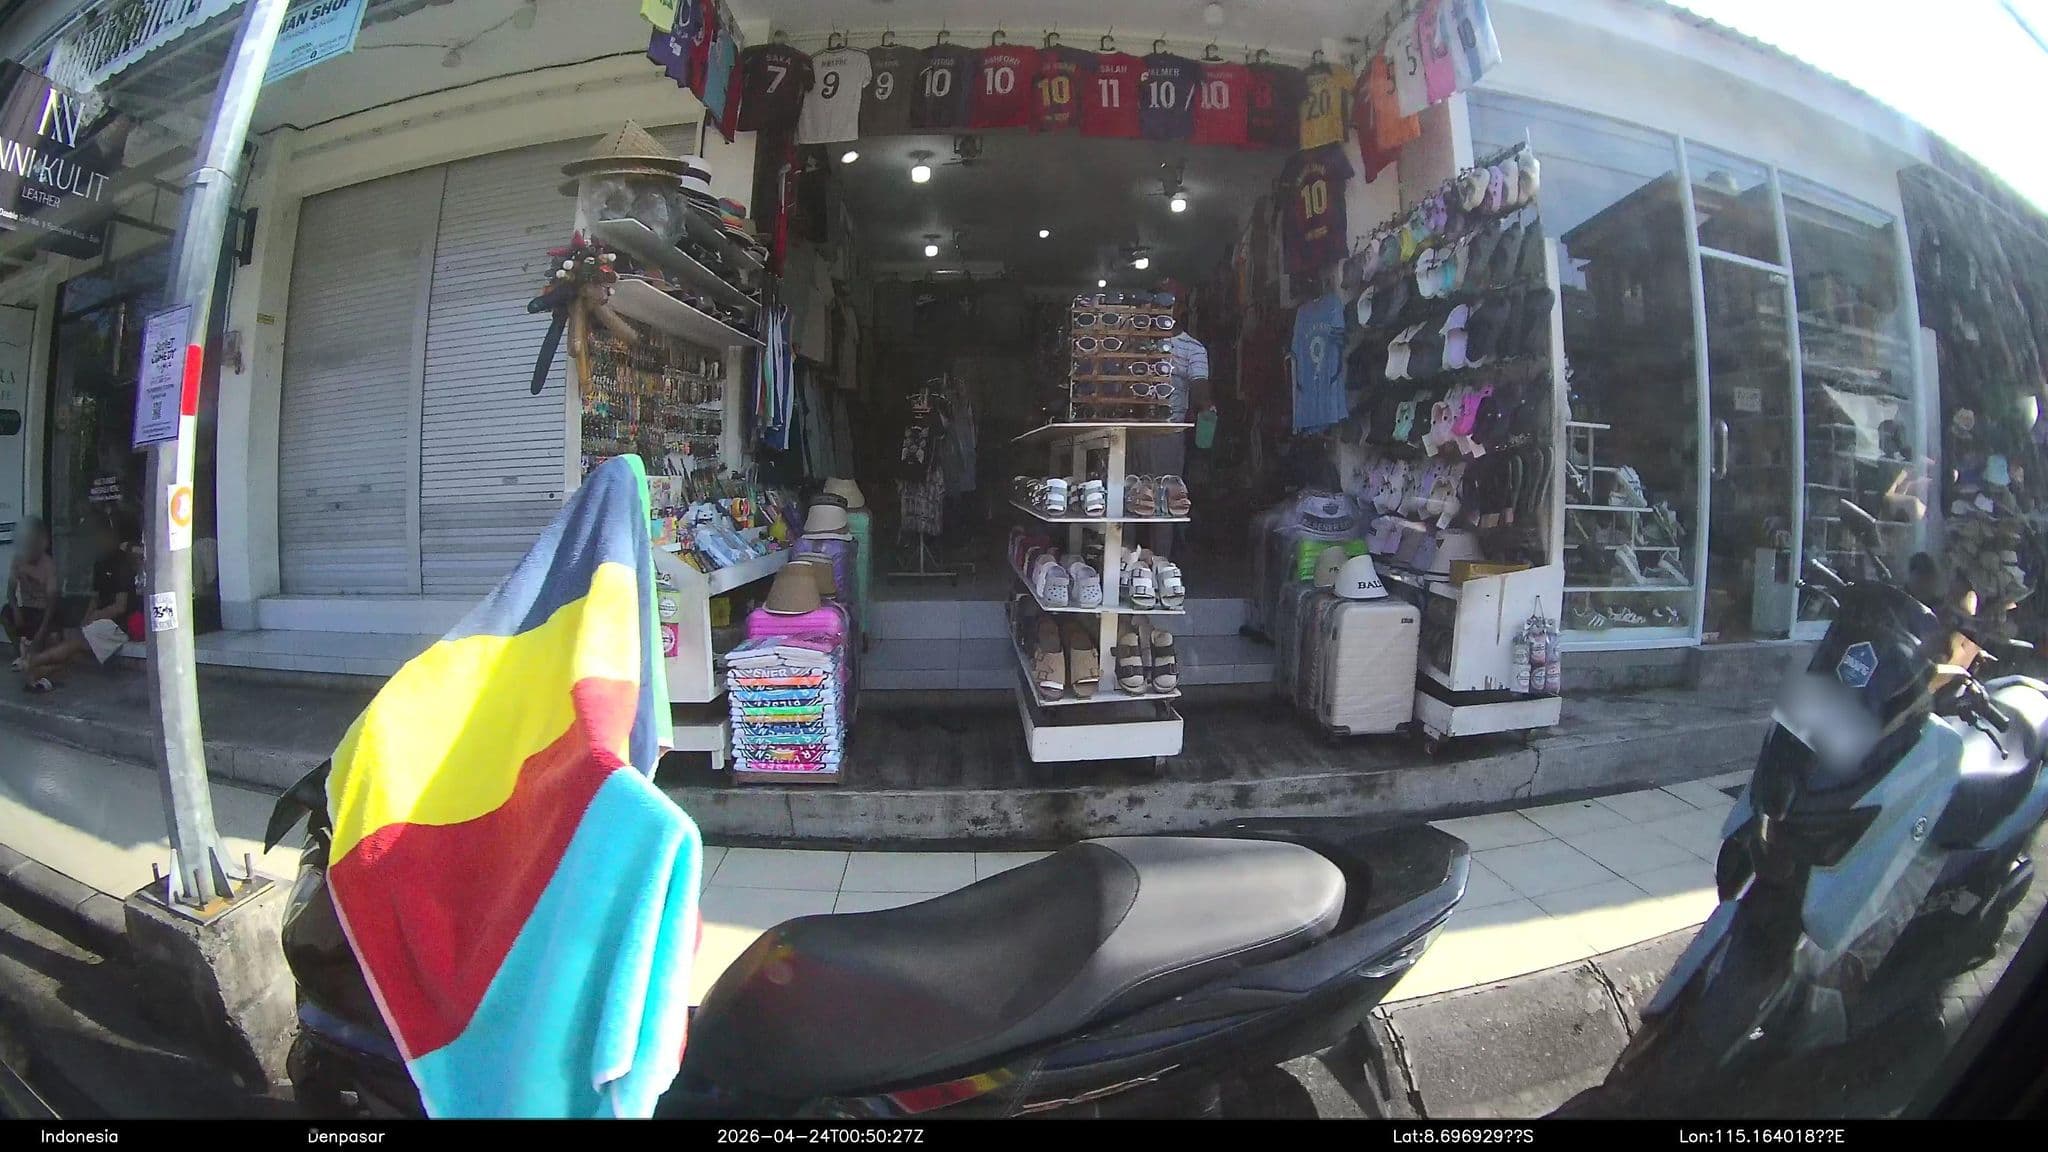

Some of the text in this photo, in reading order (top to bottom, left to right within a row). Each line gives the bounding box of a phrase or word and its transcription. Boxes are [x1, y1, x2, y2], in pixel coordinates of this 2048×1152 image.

[766, 65, 788, 95] 7
[920, 66, 952, 97] 10
[983, 66, 1016, 96] 10
[1099, 65, 1128, 74] SALAH
[820, 70, 841, 100] 9
[874, 71, 895, 101] 9
[1038, 75, 1071, 107] 10
[1098, 78, 1120, 109] 11
[1148, 80, 1176, 109] 10
[1200, 80, 1231, 110] 10
[39, 153, 110, 202] KULIT
[21, 185, 61, 209] LEATHER
[1300, 179, 1328, 220] 10
